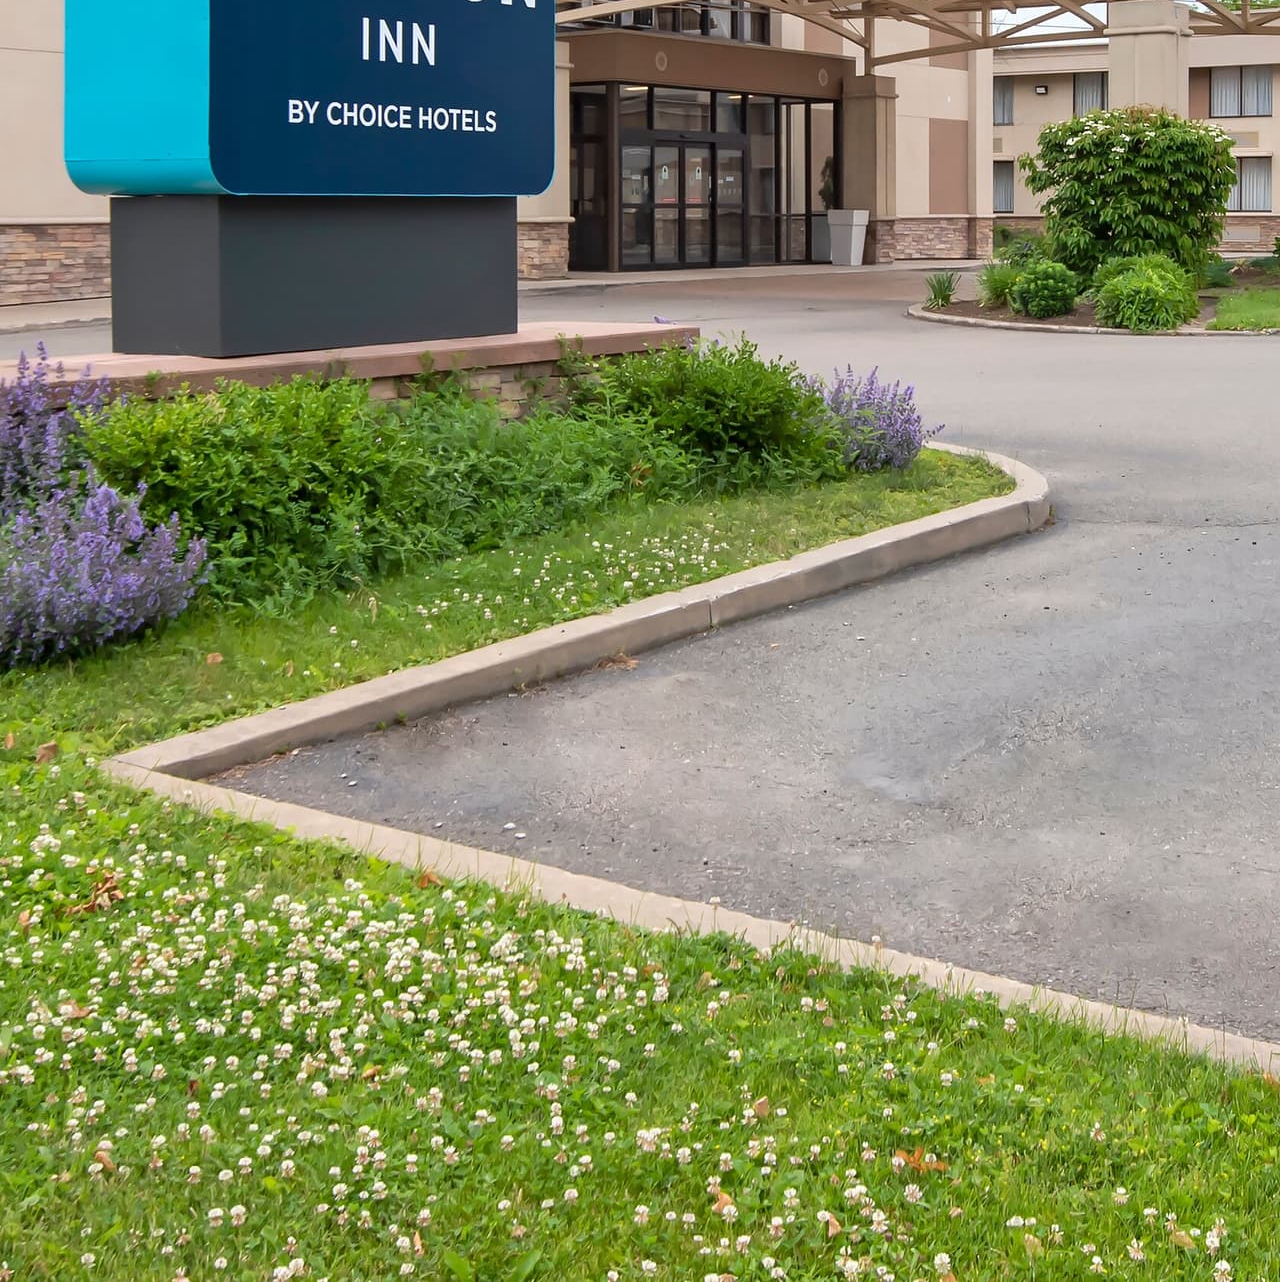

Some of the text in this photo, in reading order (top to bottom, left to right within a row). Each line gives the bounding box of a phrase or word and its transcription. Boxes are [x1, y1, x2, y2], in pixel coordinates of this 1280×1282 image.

[362, 17, 435, 66] INN
[288, 99, 497, 133] BY CHOICE HOTELS
